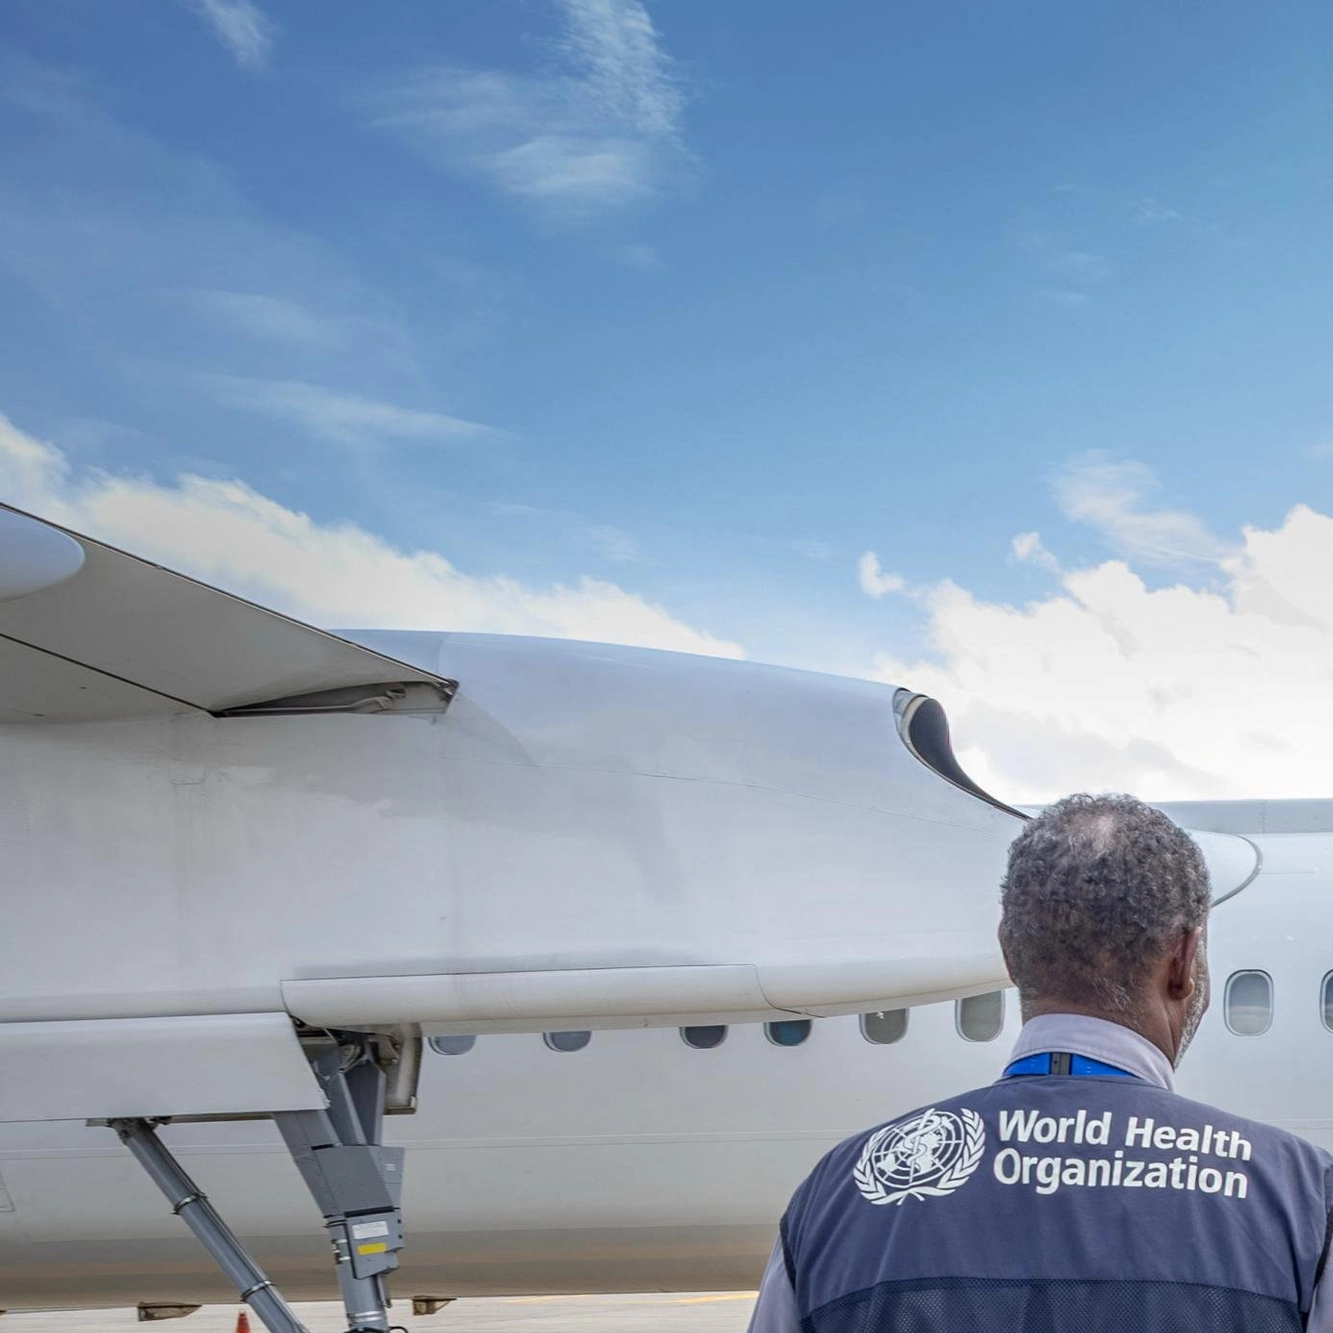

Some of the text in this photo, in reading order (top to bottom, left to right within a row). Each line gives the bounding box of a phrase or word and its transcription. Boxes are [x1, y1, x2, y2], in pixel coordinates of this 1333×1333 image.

[998, 1109, 1253, 1162] World Health
[993, 1147, 1249, 1199] Organization
